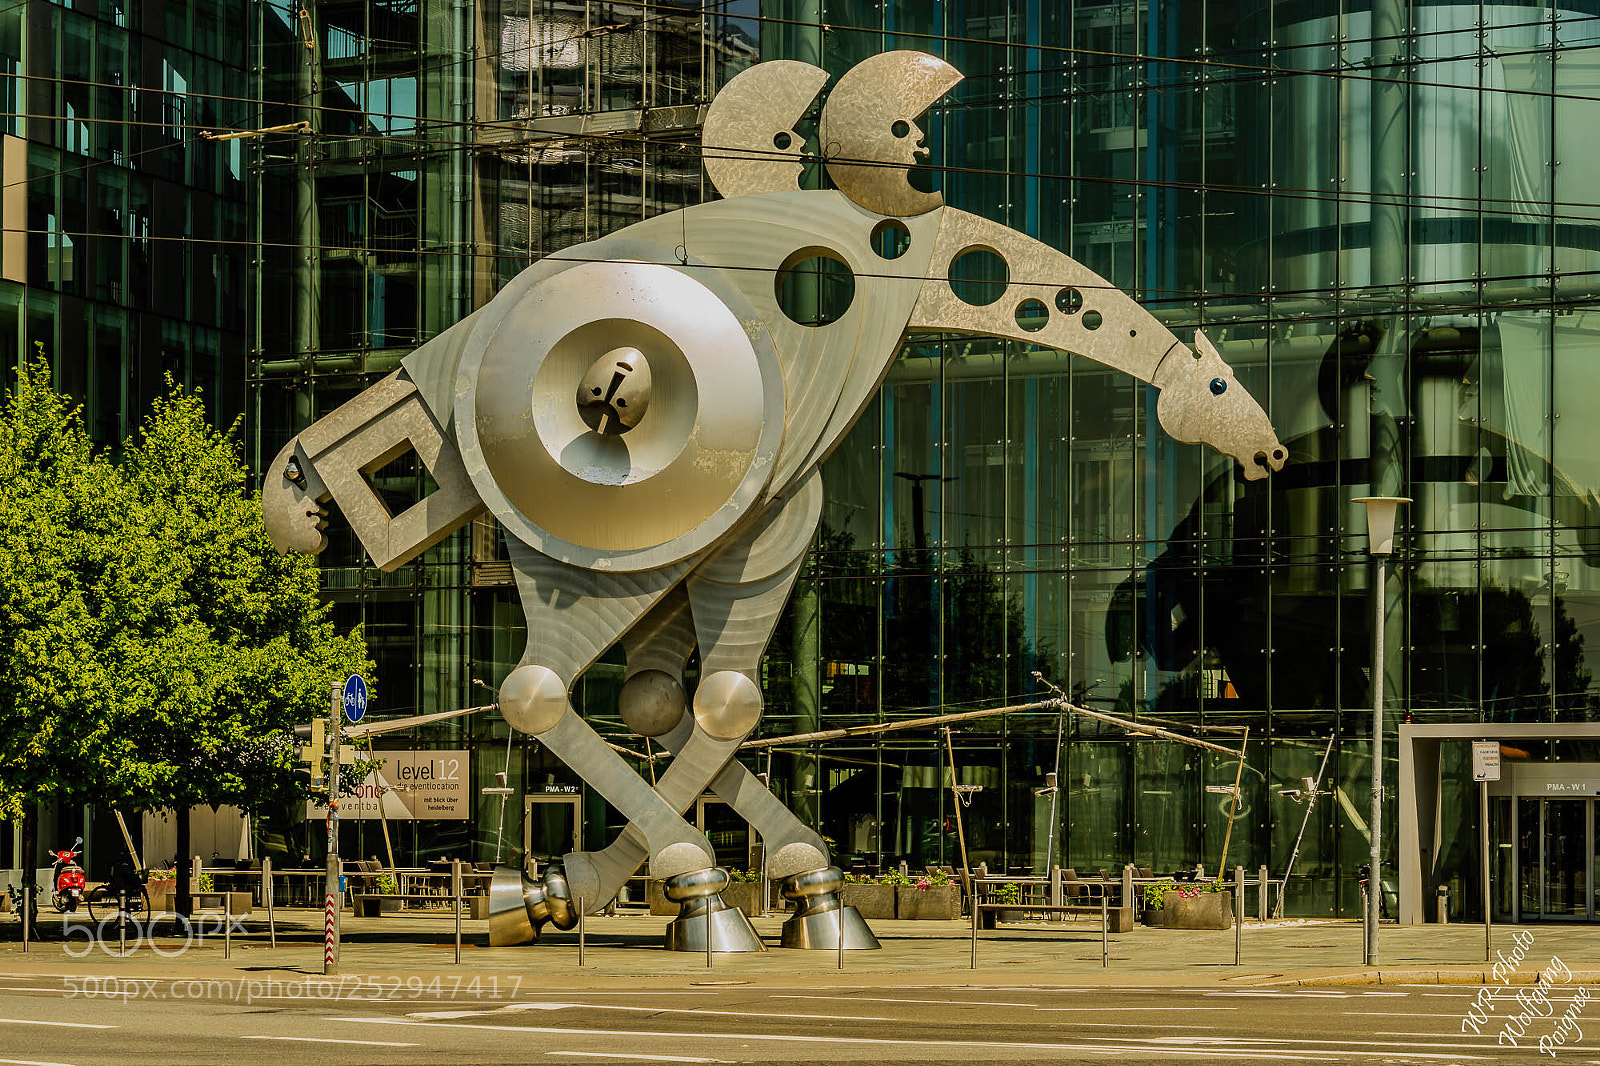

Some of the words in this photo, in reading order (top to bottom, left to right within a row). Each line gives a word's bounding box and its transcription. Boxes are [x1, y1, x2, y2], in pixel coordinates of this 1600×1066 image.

[397, 759, 435, 780] level
[438, 759, 459, 780] 12
[410, 782, 459, 790] eventlocation
[1547, 783, 1565, 791] PMA
[427, 804, 455, 812] heidelberg
